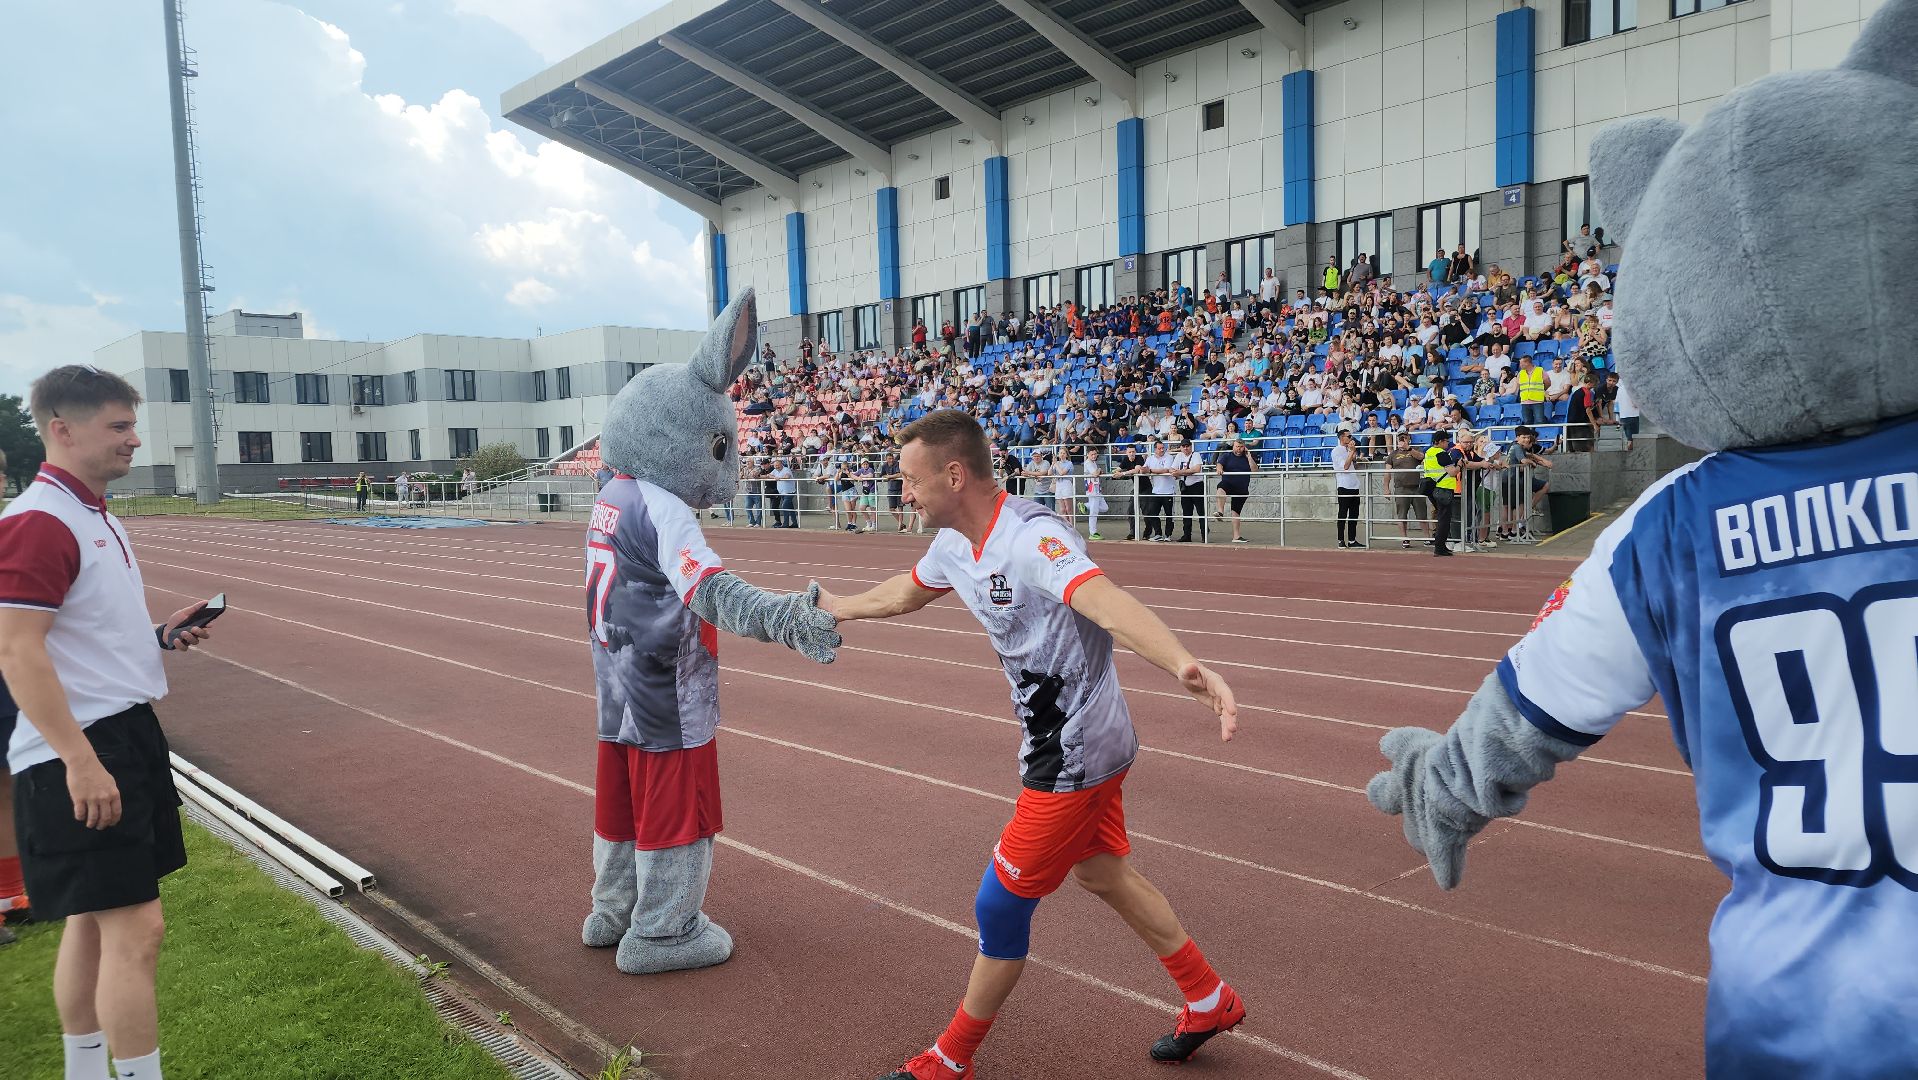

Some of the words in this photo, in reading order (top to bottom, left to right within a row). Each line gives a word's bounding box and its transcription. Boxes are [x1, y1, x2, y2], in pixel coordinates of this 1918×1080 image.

[1509, 194, 1516, 202] 4
[1127, 261, 1133, 270] 3
[1714, 471, 1918, 571] ВОЛКО
